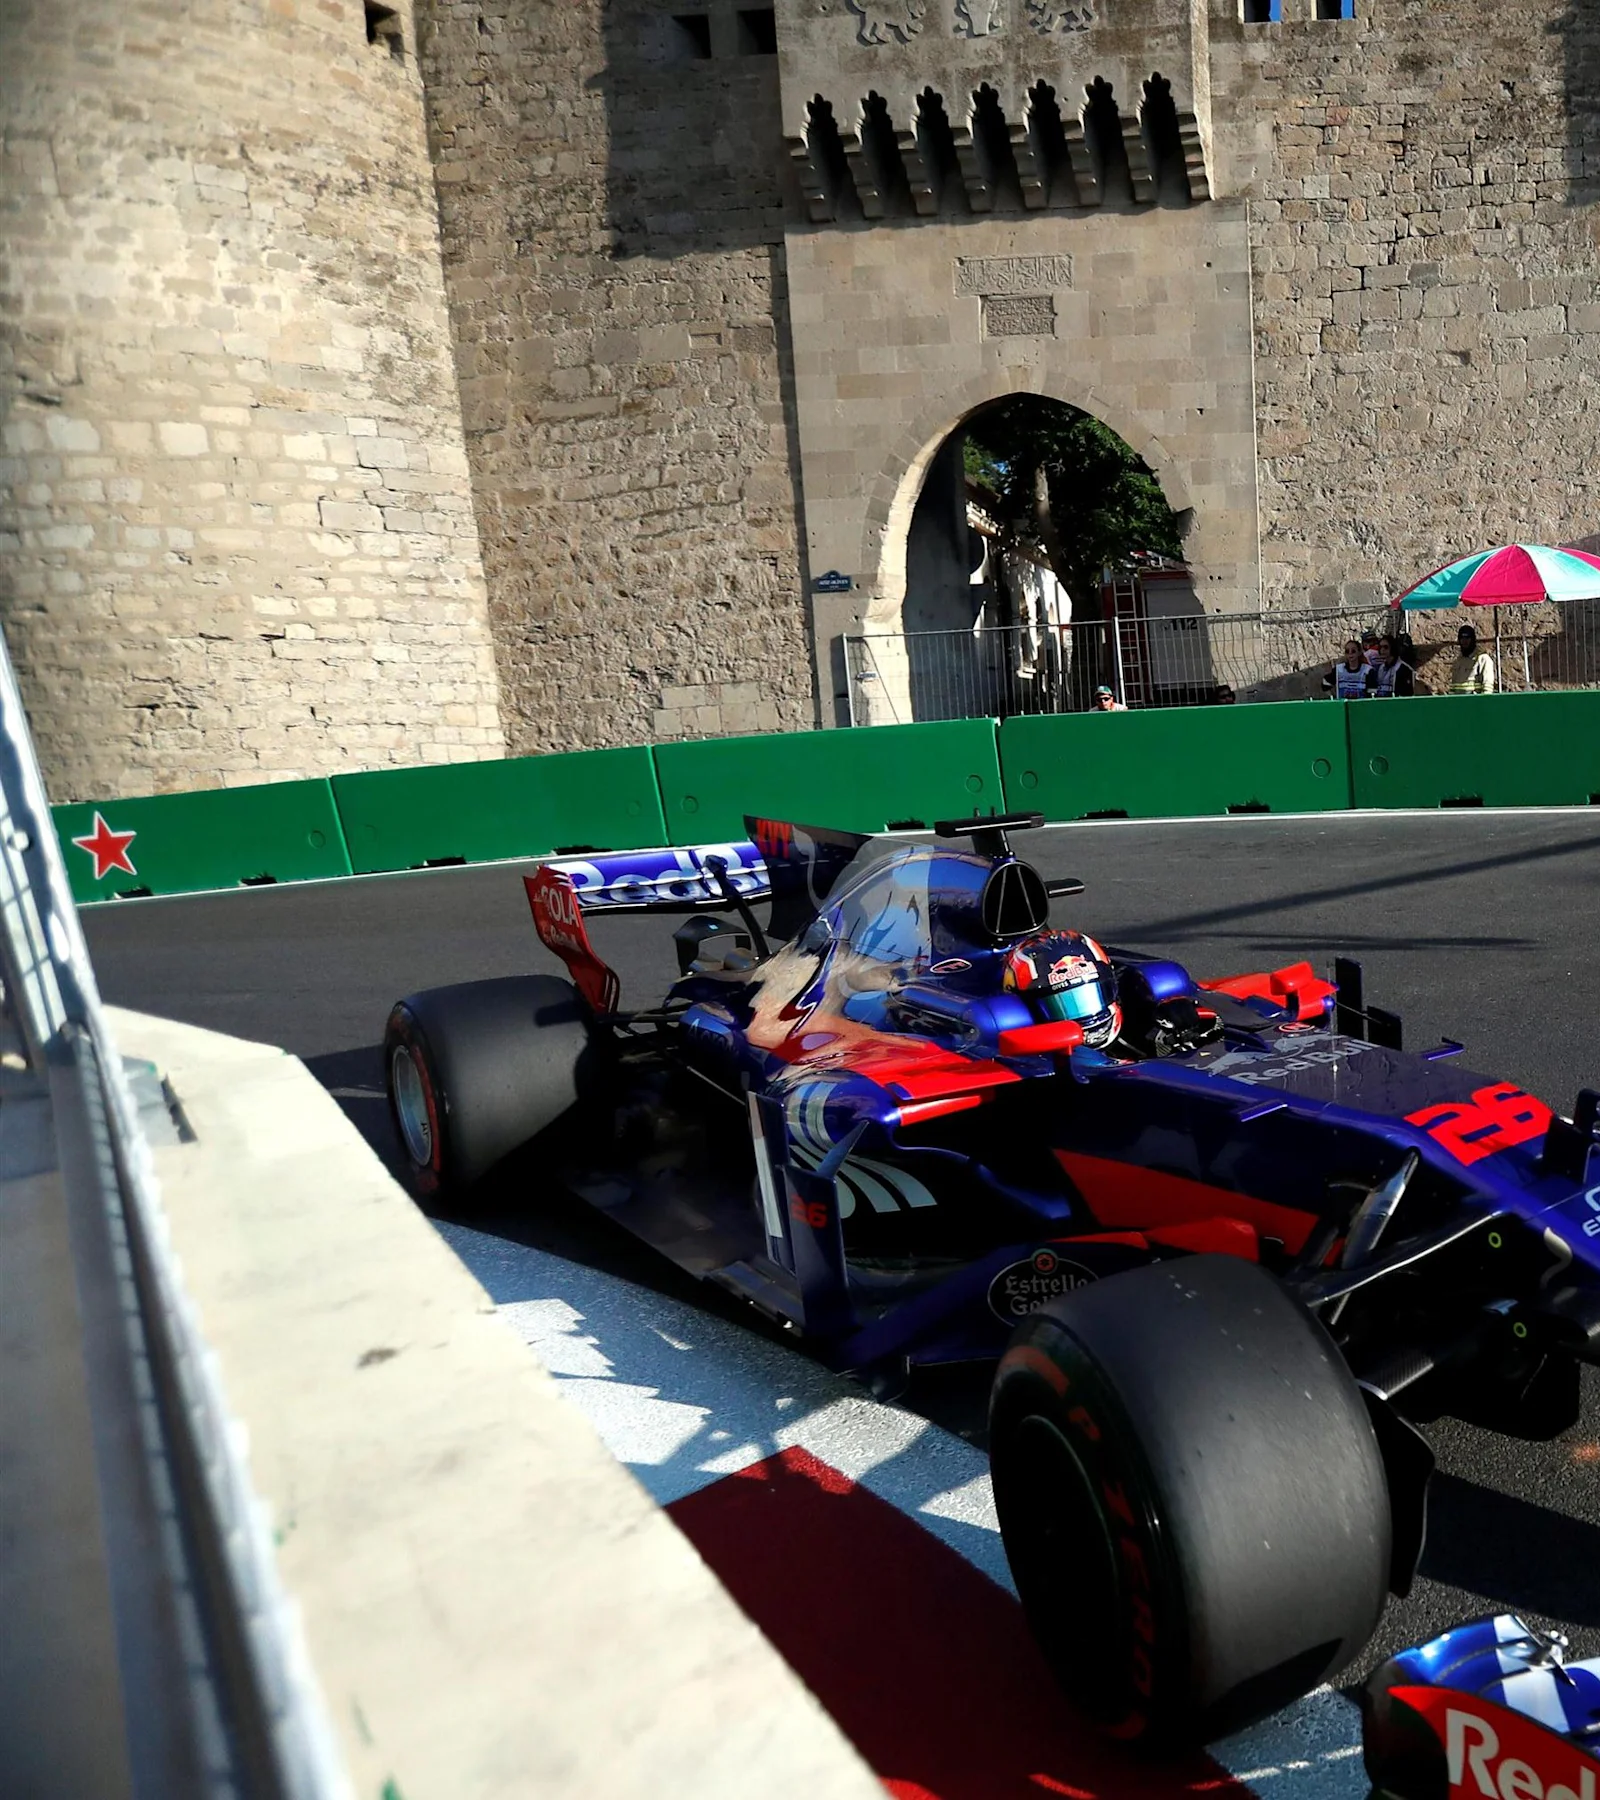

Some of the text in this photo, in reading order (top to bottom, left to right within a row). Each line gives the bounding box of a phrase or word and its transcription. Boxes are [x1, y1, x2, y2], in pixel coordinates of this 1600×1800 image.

[1049, 967, 1073, 984] Red
[1072, 961, 1097, 977] Bull
[1228, 1038, 1382, 1086] Red Bull
[1404, 1081, 1554, 1167] 26
[789, 1193, 829, 1229] 26
